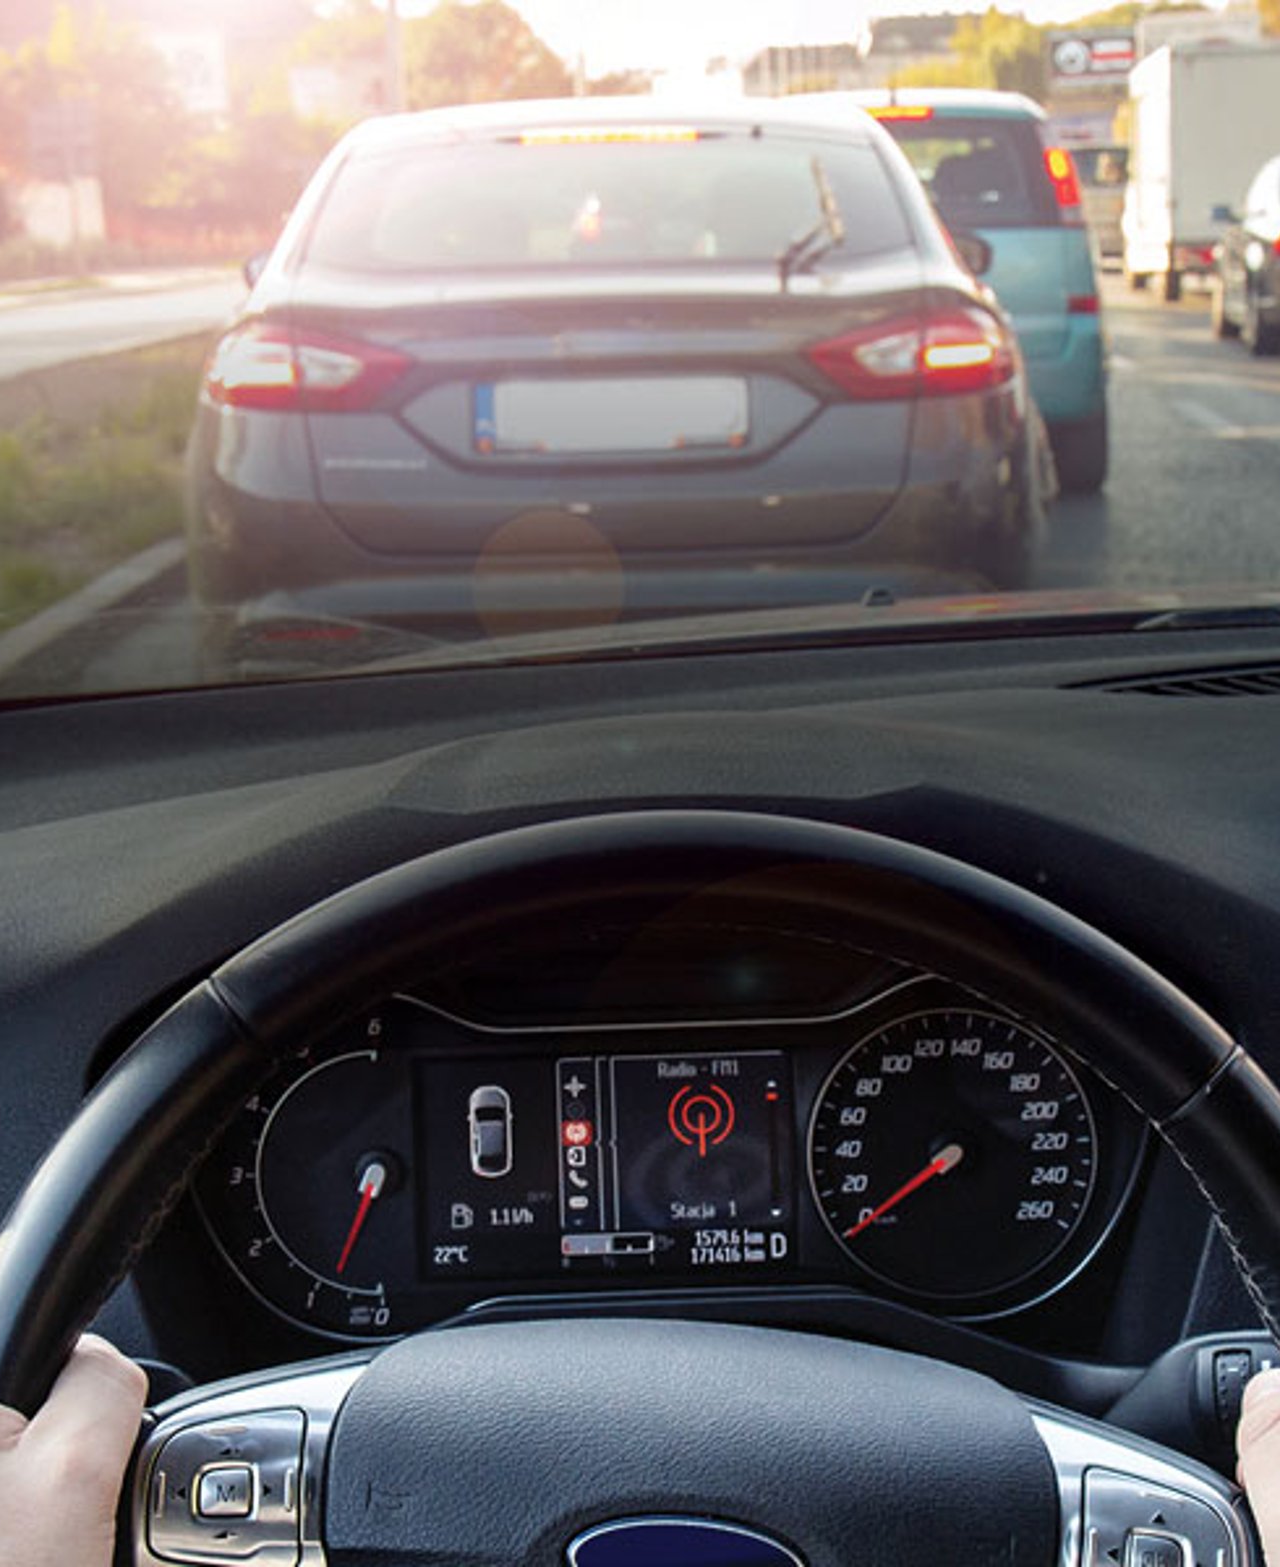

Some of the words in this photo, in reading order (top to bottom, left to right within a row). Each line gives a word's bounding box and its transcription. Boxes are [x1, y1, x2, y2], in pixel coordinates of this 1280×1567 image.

[914, 1039, 945, 1057] 120
[950, 1038, 982, 1056] 140
[657, 1062, 697, 1078] Radio
[712, 1059, 740, 1076] FM1
[881, 1054, 912, 1073] 100
[982, 1052, 1014, 1070] 160
[856, 1078, 882, 1097] 80
[1010, 1073, 1040, 1092] 180
[246, 1095, 260, 1111] 4
[1021, 1101, 1058, 1120] 200
[840, 1107, 866, 1126] 60
[835, 1140, 862, 1158] 40
[1031, 1132, 1068, 1151] 220
[229, 1166, 244, 1185] 3
[841, 1174, 868, 1193] 20
[1031, 1166, 1069, 1185] 240
[729, 1200, 737, 1217] 1
[1015, 1201, 1054, 1220] 260
[695, 1229, 741, 1246] 1579.6
[769, 1232, 787, 1258] D
[248, 1239, 263, 1257] 2
[306, 1291, 315, 1309] 1
[373, 1307, 390, 1326] 0
[216, 1484, 236, 1503] M
